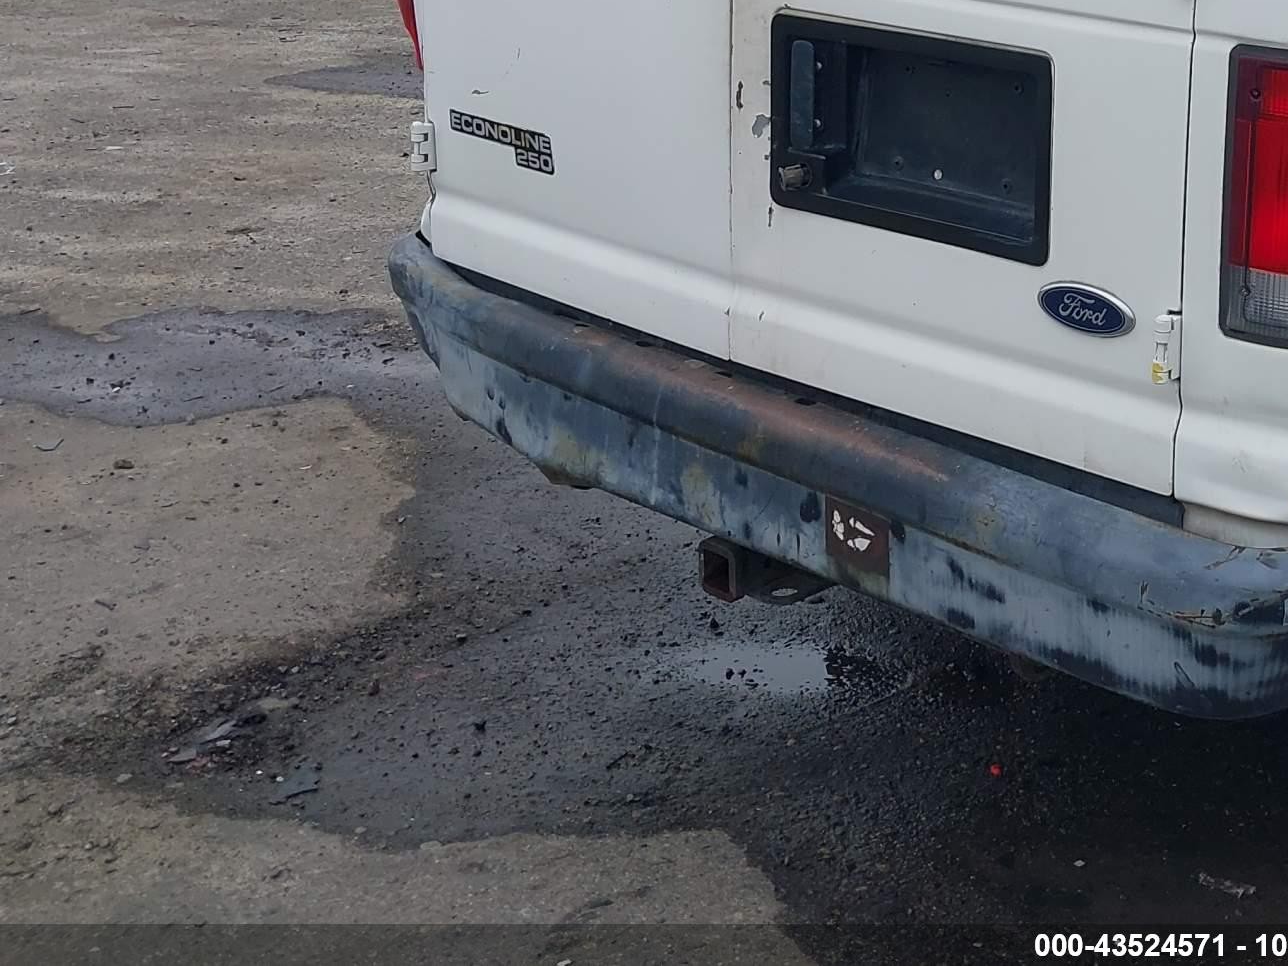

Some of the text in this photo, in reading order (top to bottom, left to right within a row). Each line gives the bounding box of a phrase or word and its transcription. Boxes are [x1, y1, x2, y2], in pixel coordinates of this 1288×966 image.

[450, 112, 551, 154] ECONOLINE
[516, 148, 553, 172] 250
[1059, 292, 1107, 325] Ford
